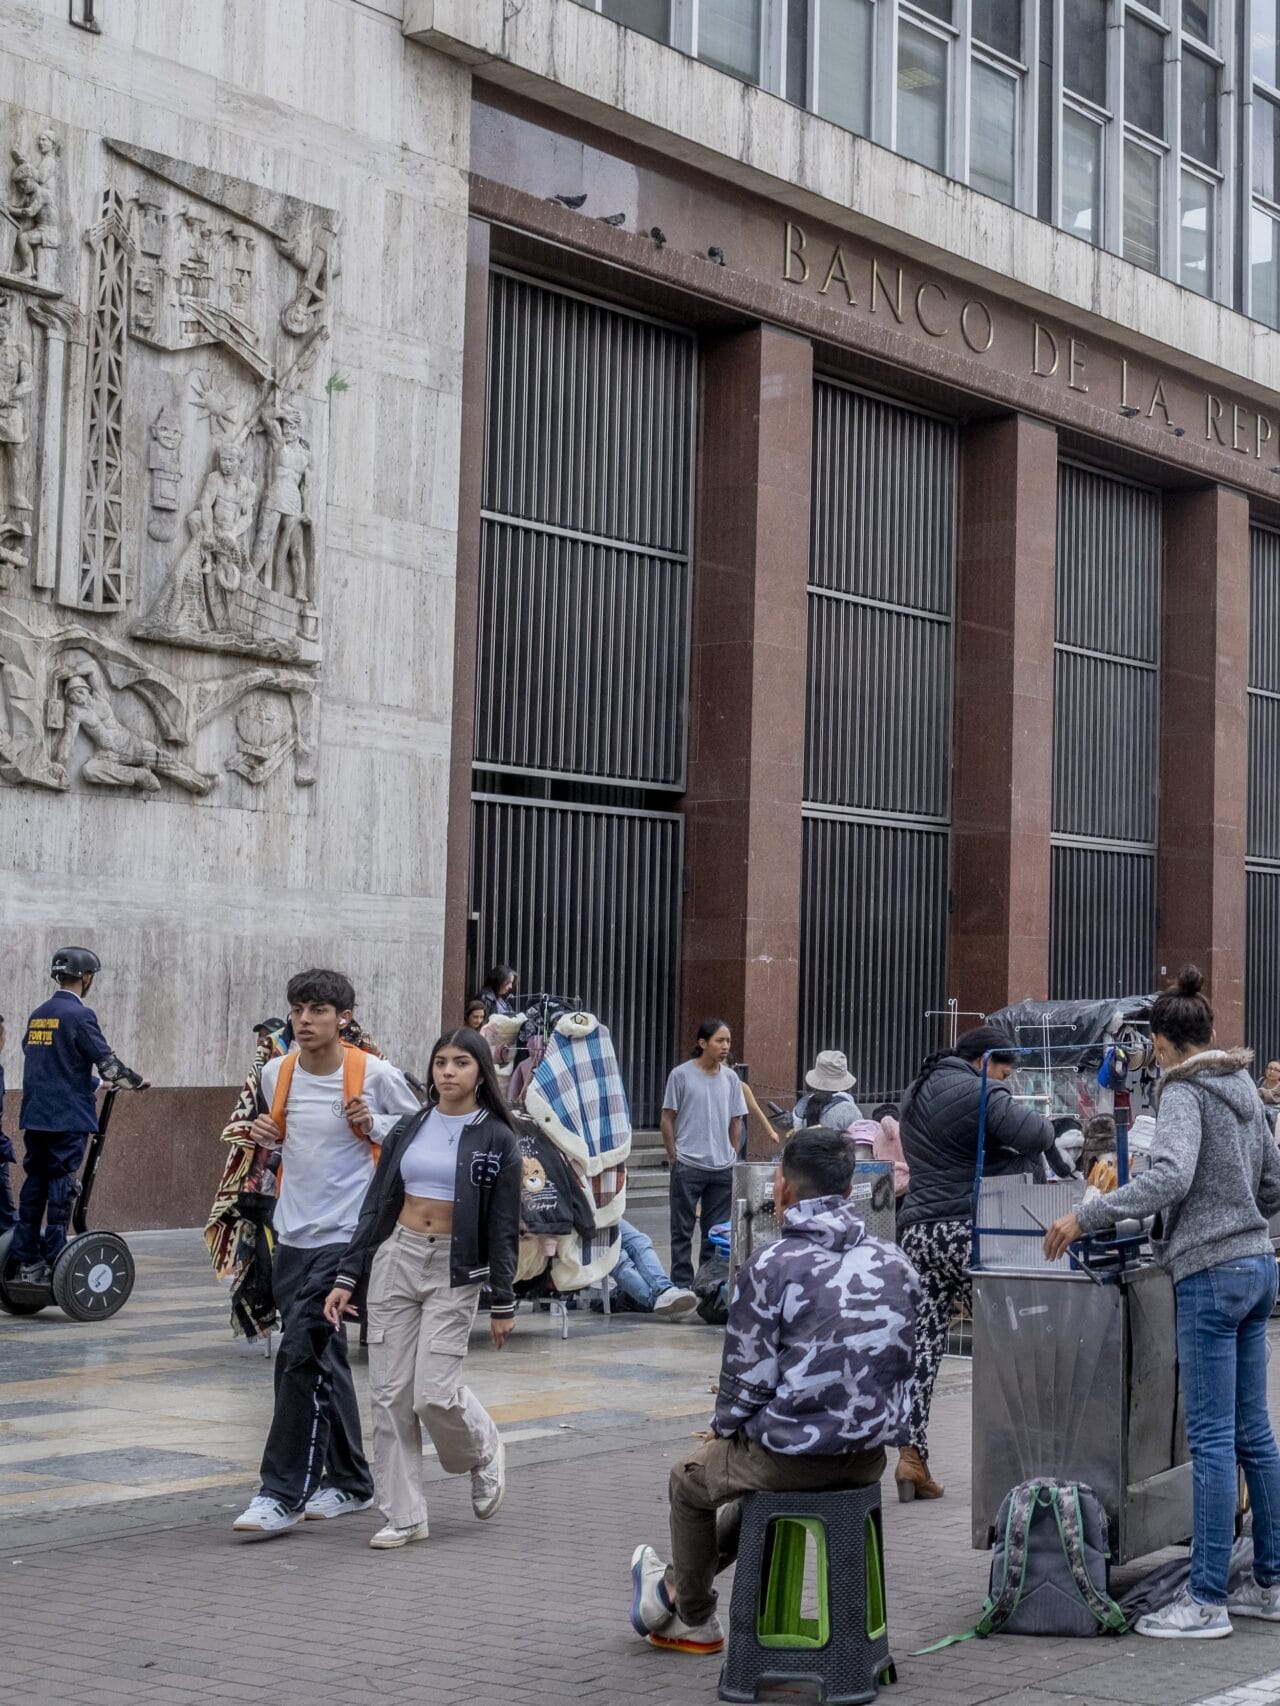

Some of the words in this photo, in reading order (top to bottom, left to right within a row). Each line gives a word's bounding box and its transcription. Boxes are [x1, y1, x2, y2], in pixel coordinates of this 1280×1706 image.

[782, 222, 995, 354] BANCO
[1032, 323, 1089, 393] DE
[1120, 357, 1173, 426] LA
